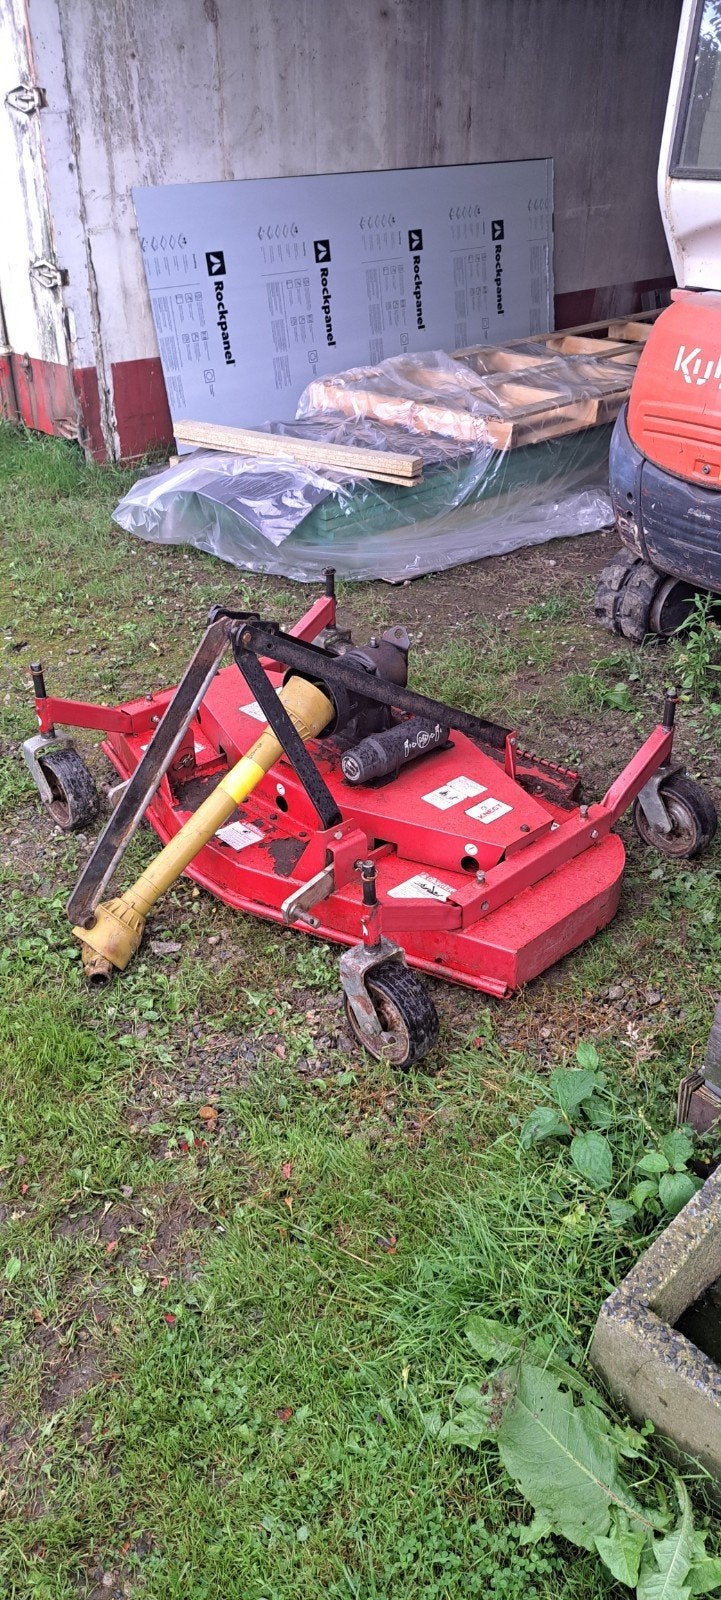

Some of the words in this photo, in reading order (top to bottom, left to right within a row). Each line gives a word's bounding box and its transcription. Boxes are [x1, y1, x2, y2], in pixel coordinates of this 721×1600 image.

[320, 267, 336, 347] Rockpanel
[413, 255, 425, 330] Rockpanel
[494, 244, 504, 315] Rockpanel
[214, 280, 235, 365] Rockpanel
